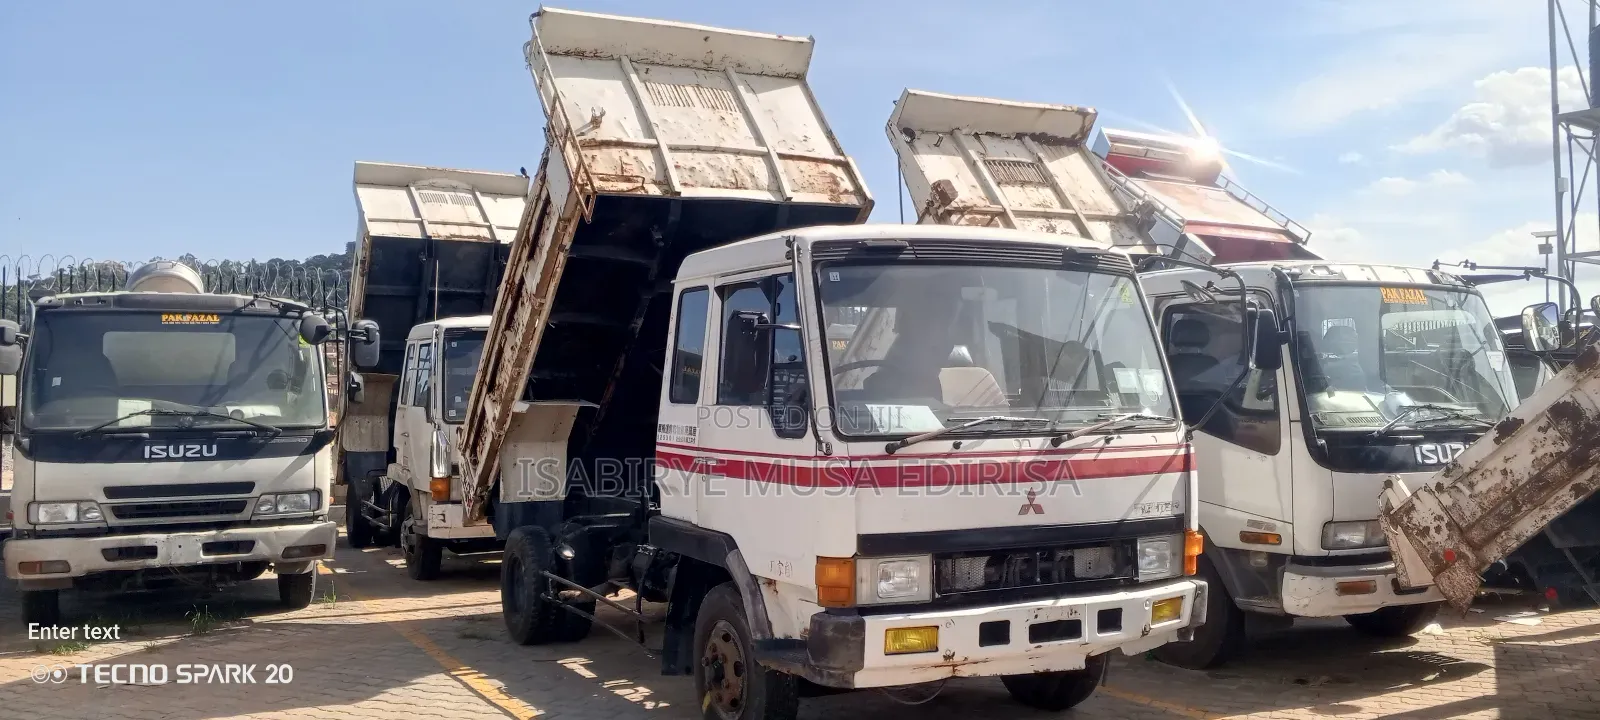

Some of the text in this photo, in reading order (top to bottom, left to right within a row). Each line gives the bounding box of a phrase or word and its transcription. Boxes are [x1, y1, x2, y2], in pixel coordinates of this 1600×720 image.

[1380, 287, 1427, 301] PAK FAZAL
[144, 444, 217, 459] ISUZU
[1414, 442, 1470, 464] ISUZ
